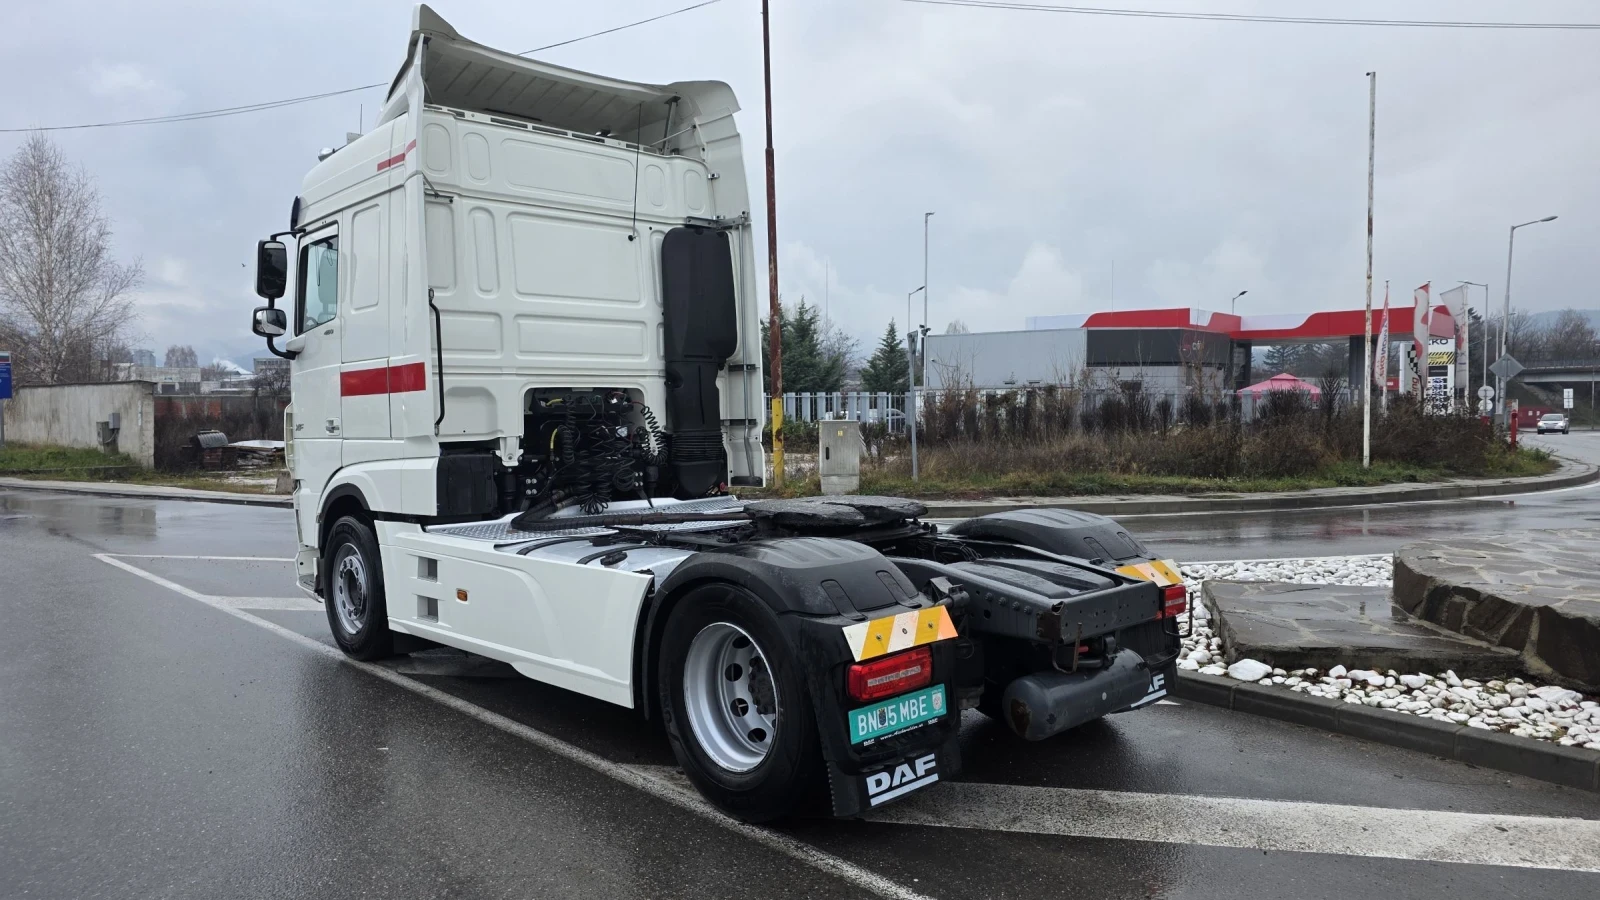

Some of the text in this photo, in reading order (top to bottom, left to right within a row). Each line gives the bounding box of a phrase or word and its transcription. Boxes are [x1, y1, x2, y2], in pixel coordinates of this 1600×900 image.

[858, 710, 878, 736] BN
[900, 695, 928, 723] MBE
[866, 753, 936, 796] DAF
